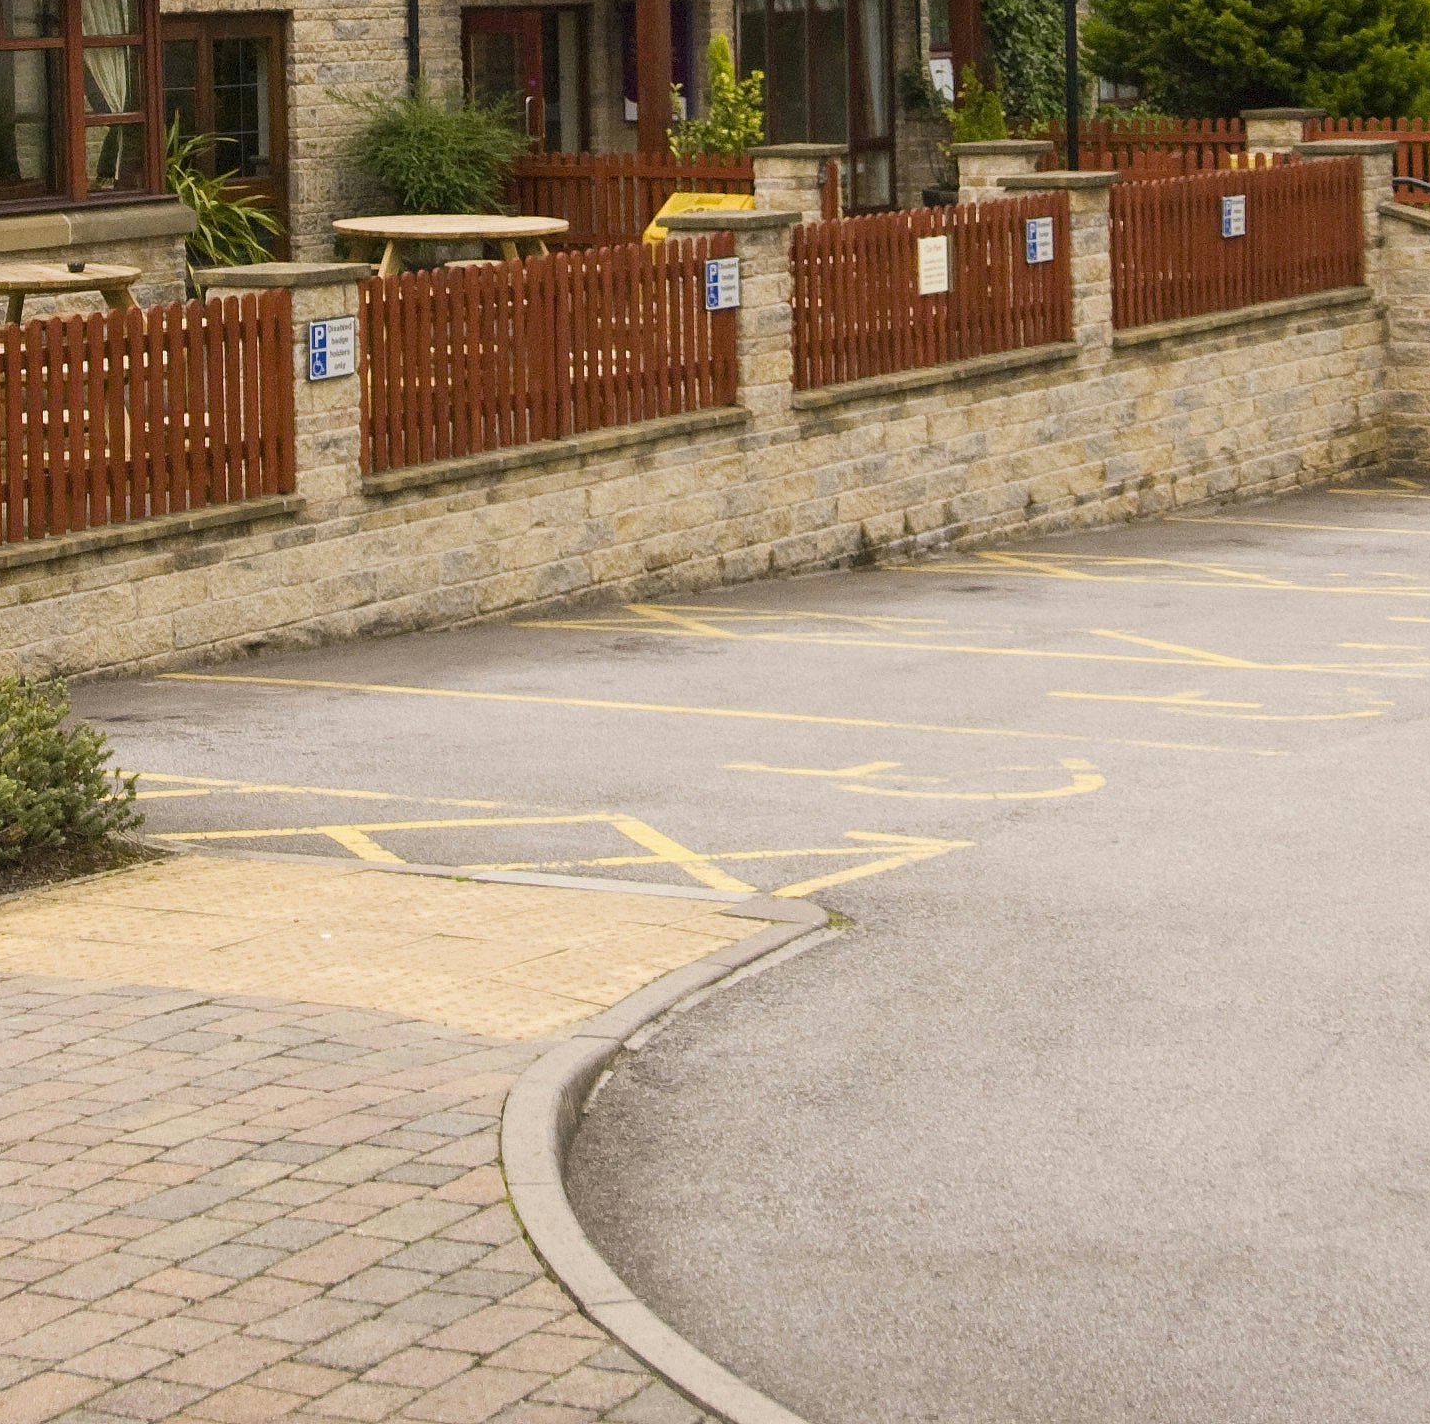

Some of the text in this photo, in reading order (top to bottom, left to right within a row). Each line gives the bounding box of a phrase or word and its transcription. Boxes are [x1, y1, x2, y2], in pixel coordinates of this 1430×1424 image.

[709, 263, 717, 283] P
[328, 323, 351, 333] Disabled
[314, 326, 325, 348] P
[334, 361, 346, 370] only
